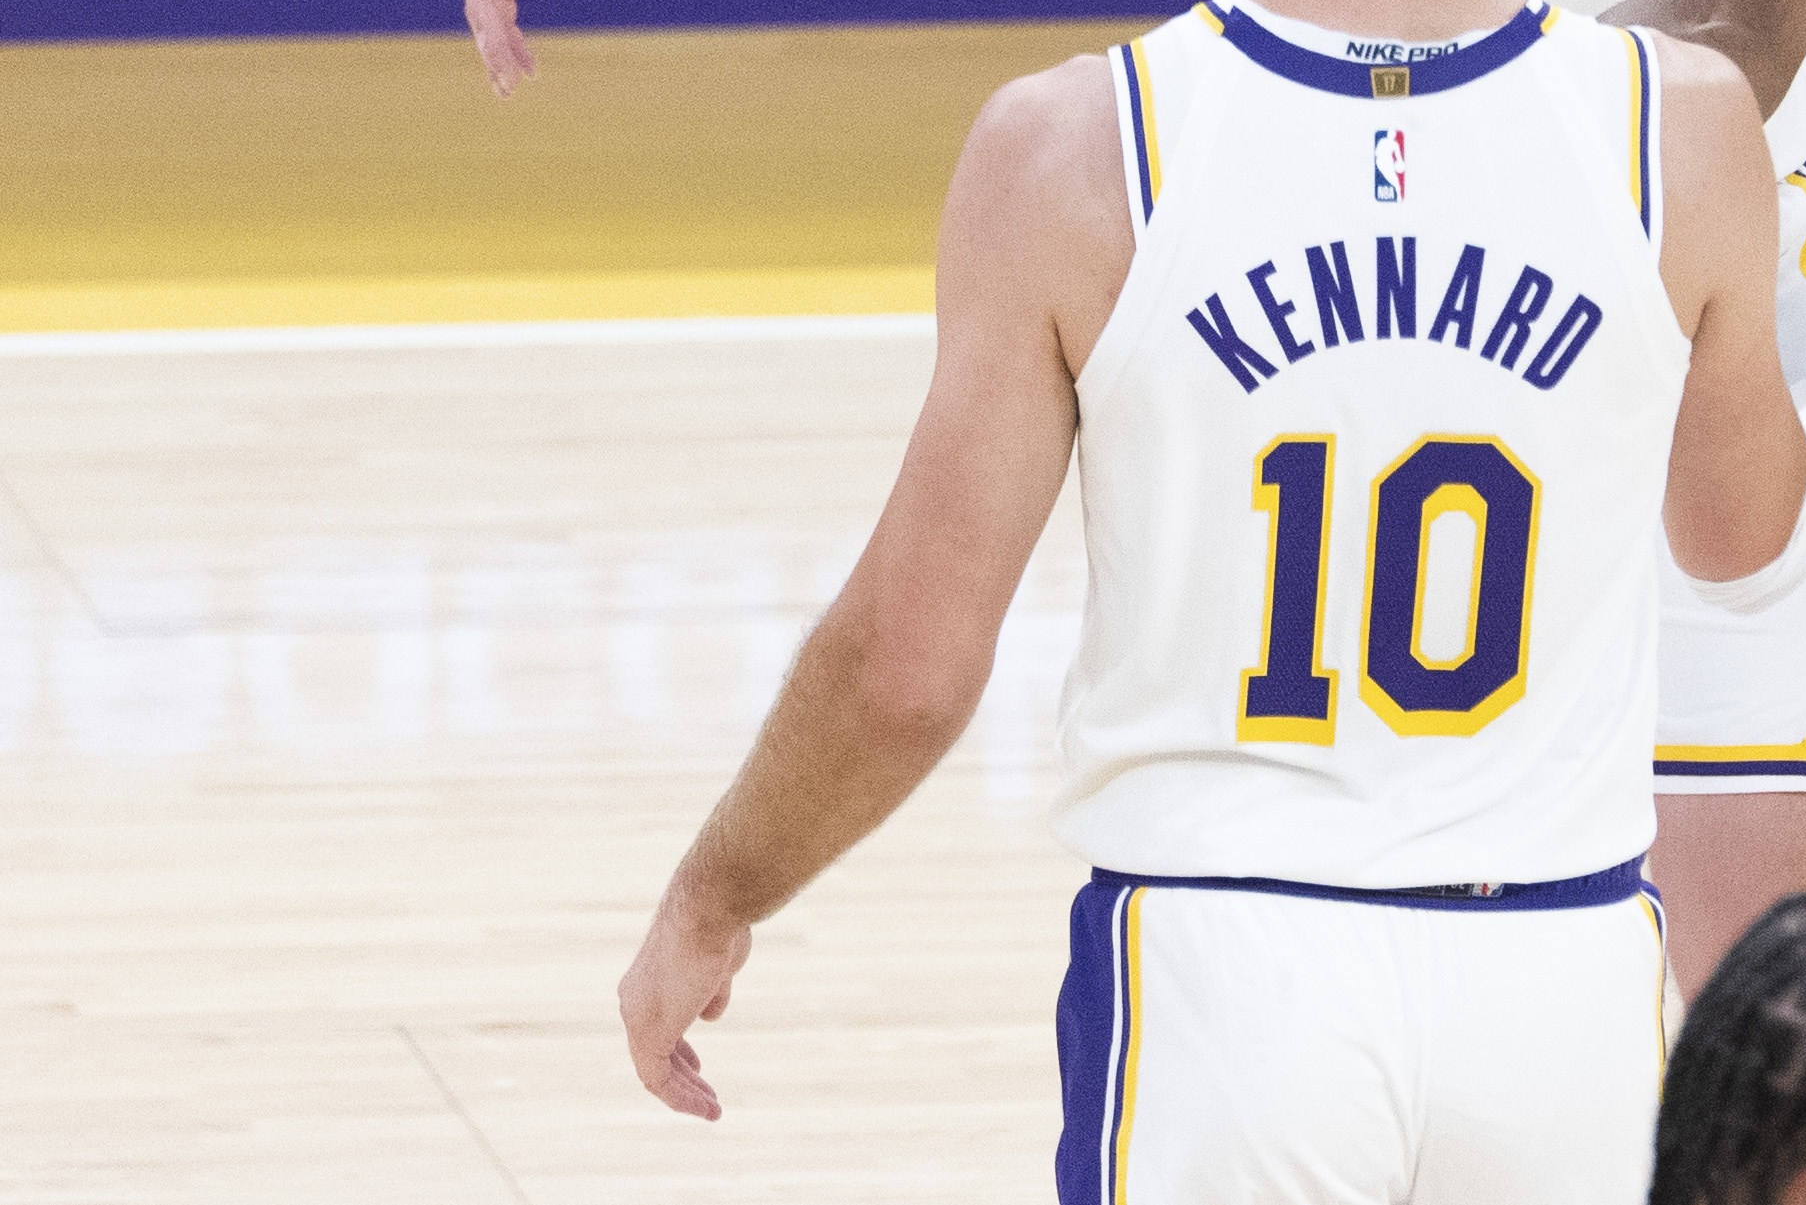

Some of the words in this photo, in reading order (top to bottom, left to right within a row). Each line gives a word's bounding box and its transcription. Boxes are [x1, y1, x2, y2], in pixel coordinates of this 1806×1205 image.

[1346, 42, 1404, 66] NIKE
[1185, 236, 1603, 395] KENNARD
[1236, 432, 1543, 747] 10
